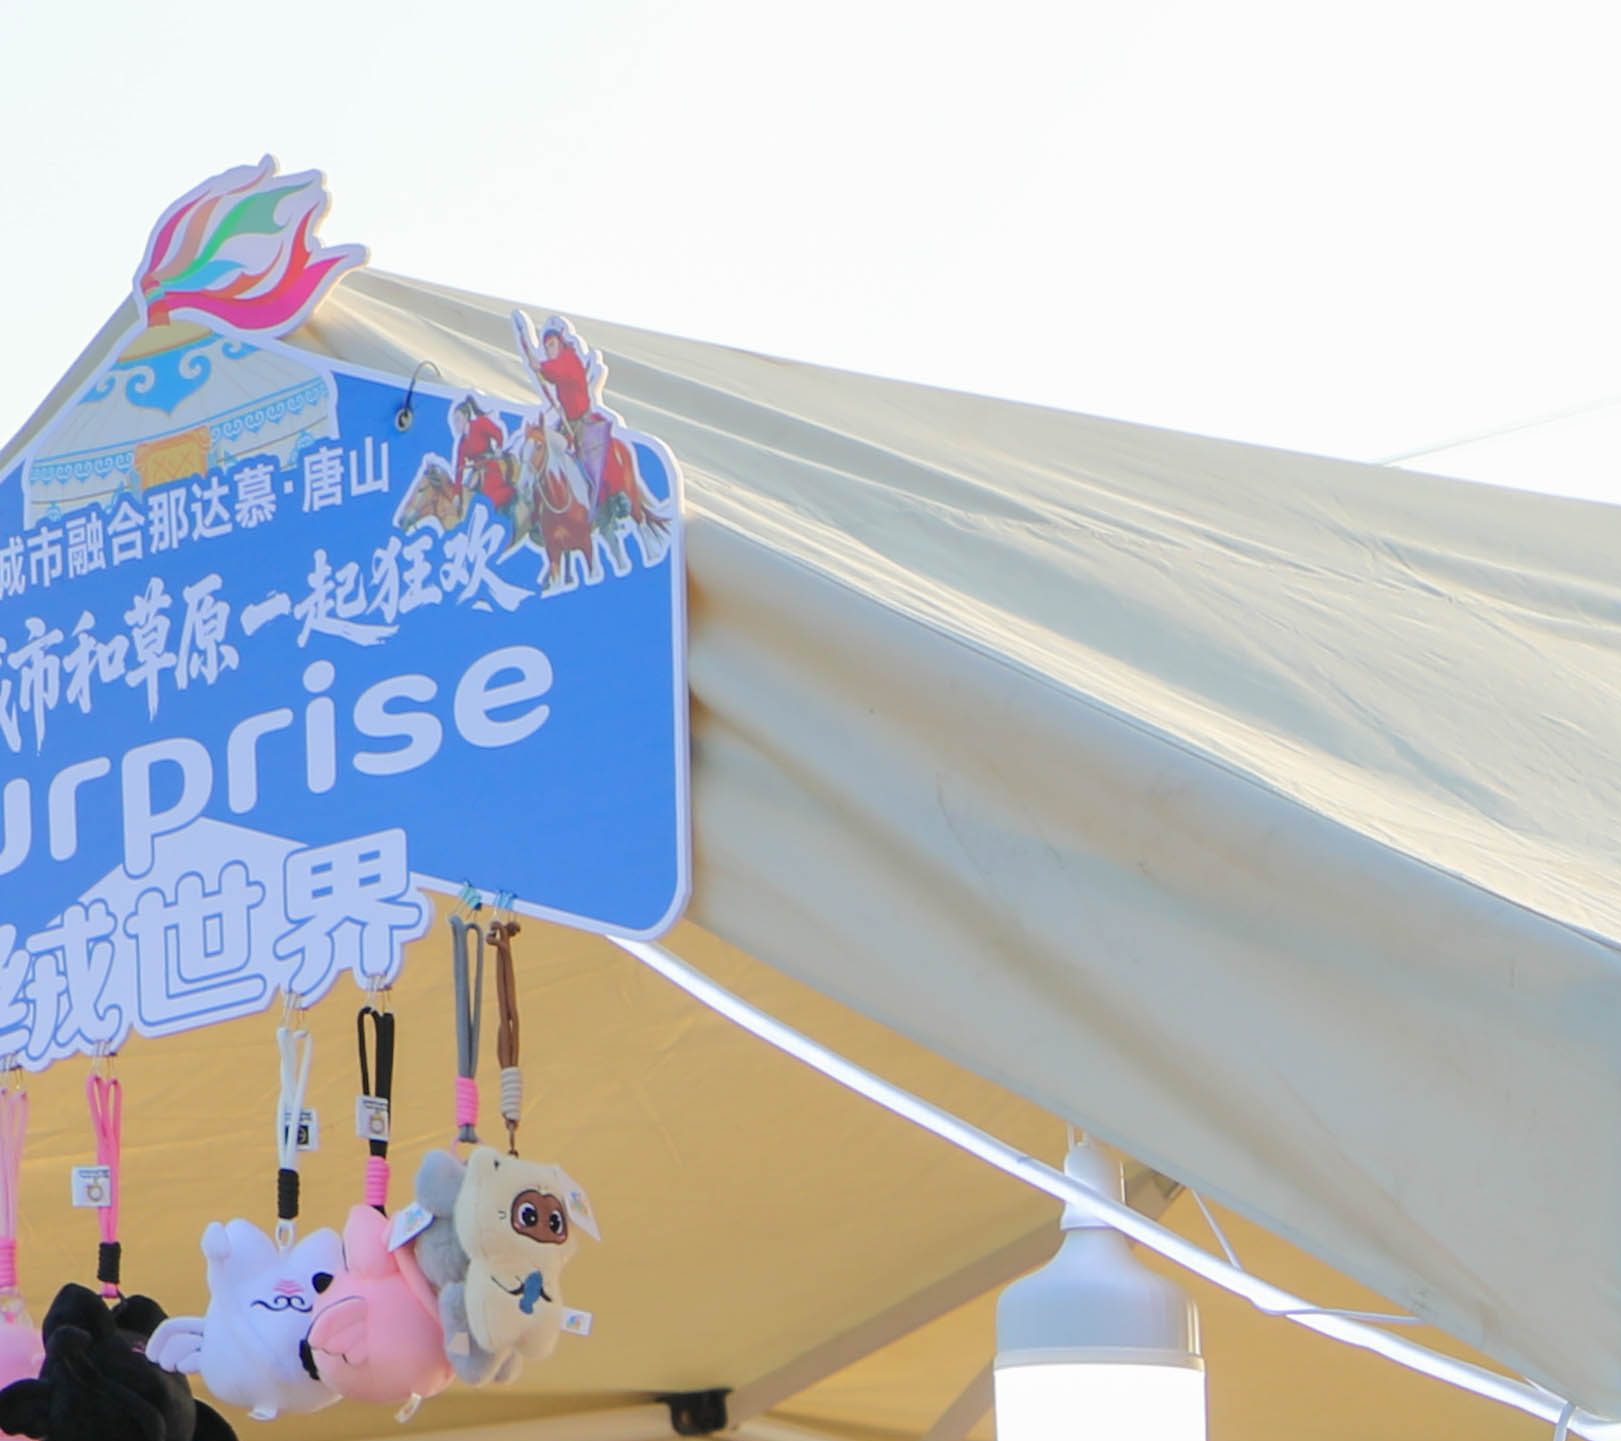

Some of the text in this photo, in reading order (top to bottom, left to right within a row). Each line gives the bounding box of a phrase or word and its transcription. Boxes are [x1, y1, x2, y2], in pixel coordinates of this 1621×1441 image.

[0, 502, 536, 757] 市和草原一起狂欢
